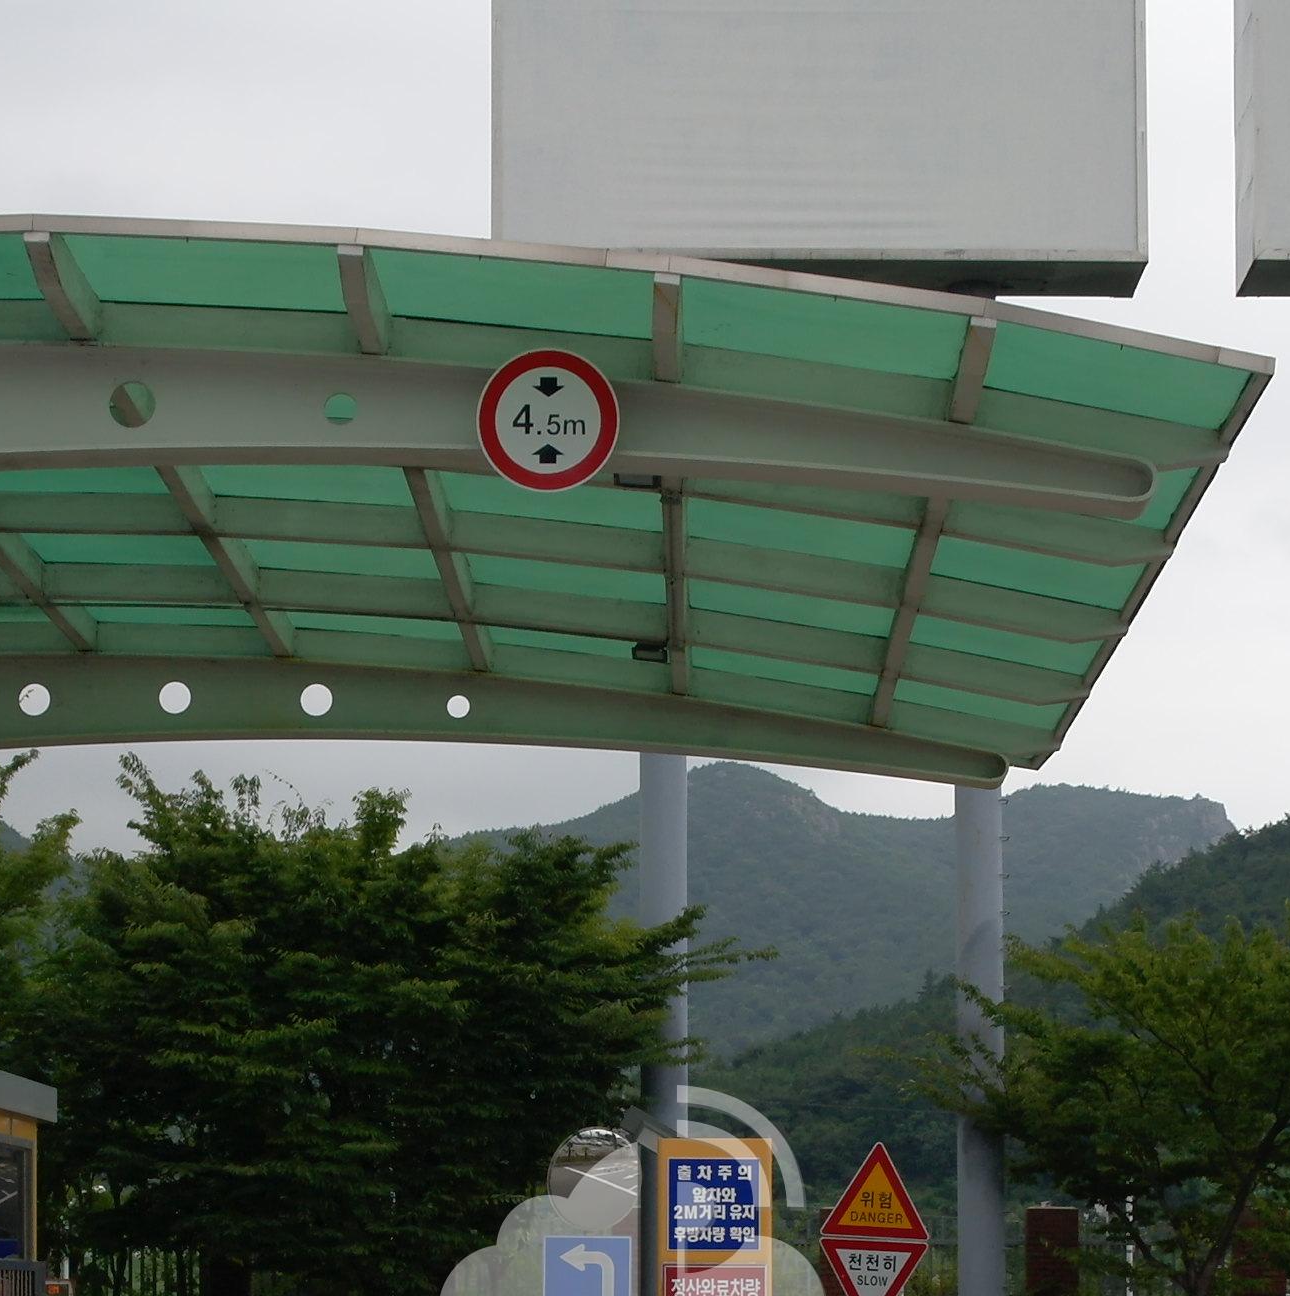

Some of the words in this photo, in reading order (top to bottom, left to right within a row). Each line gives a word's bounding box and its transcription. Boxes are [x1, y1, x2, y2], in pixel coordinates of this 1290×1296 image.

[512, 404, 586, 435] 4.5m
[692, 1187, 737, 1203] 앞차와
[860, 1192, 893, 1209] 위험
[730, 1206, 755, 1220] 유지
[850, 1211, 903, 1224] DANGER
[674, 1226, 725, 1242] 후방차량
[729, 1226, 756, 1242] 확인
[848, 1253, 896, 1272] 천천히
[856, 1276, 889, 1287] SLOW
